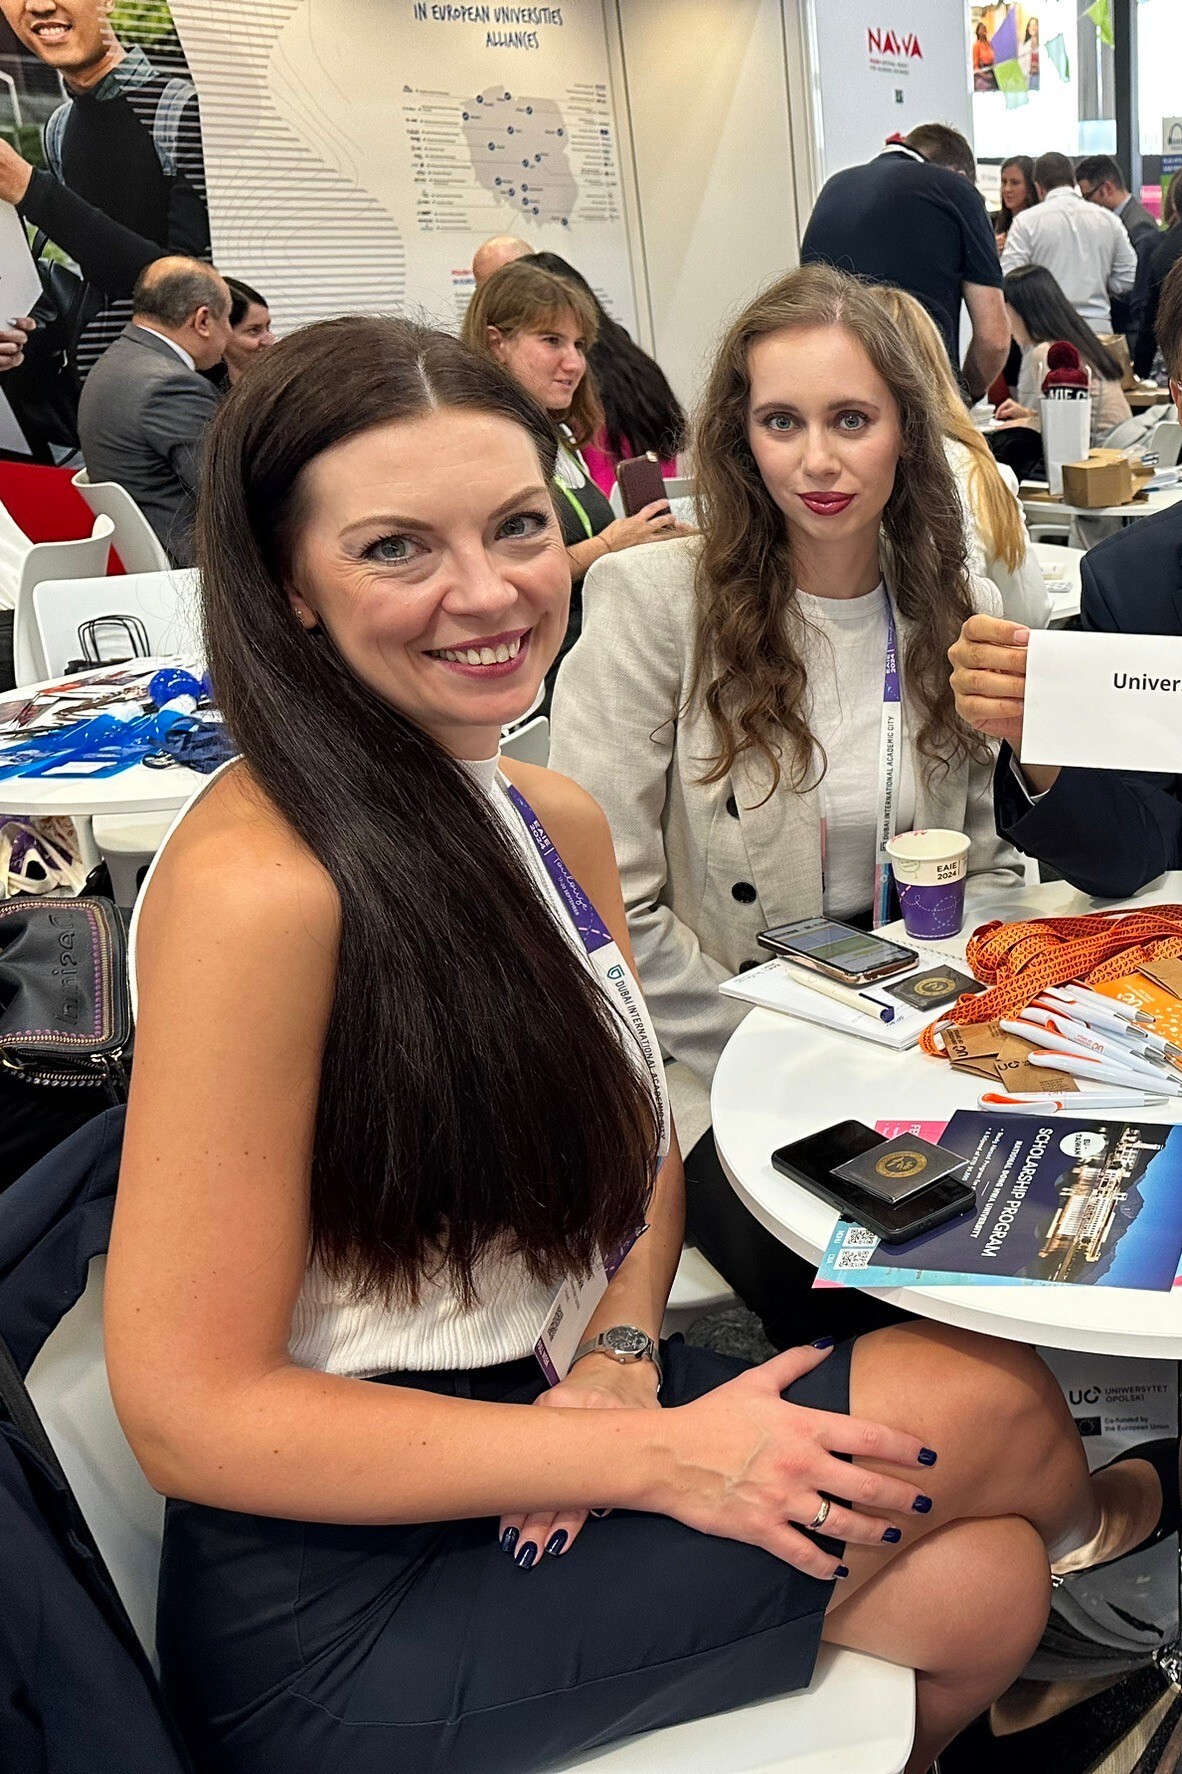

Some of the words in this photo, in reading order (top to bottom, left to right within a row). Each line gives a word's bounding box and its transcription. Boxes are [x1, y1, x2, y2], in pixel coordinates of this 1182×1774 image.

[413, 2, 428, 21] IN
[431, 4, 490, 23] EUROPEAN
[494, 6, 563, 26] UNIVERSITIES
[486, 31, 540, 50] ALLIANCES
[867, 26, 924, 60] NAWA
[887, 715, 895, 732] CITY
[886, 732, 894, 766] ACADEMIC
[884, 768, 894, 820] INTERNATIONAL
[529, 824, 547, 851] 2024
[533, 819, 551, 847] EAIE
[936, 861, 957, 873] EAIE
[937, 871, 957, 881] 2024
[553, 854, 588, 911] Toulouse
[563, 890, 579, 917] SEPTEMBER
[615, 980, 633, 1005] DUBAI
[626, 1002, 657, 1074] INTERNATIONAL
[1003, 1140, 1024, 1170] NATIONAL
[1011, 1127, 1052, 1200] SCHOLARSHIP
[995, 1169, 1010, 1188] DONG
[987, 1187, 1002, 1203] HWA
[970, 1202, 994, 1239] UNIVERSITY
[980, 1200, 1022, 1257] PROGRAM
[1105, 1384, 1168, 1395] UNIWERSYTET
[1105, 1394, 1145, 1404] OPOLSKI
[1117, 1424, 1149, 1432] European
